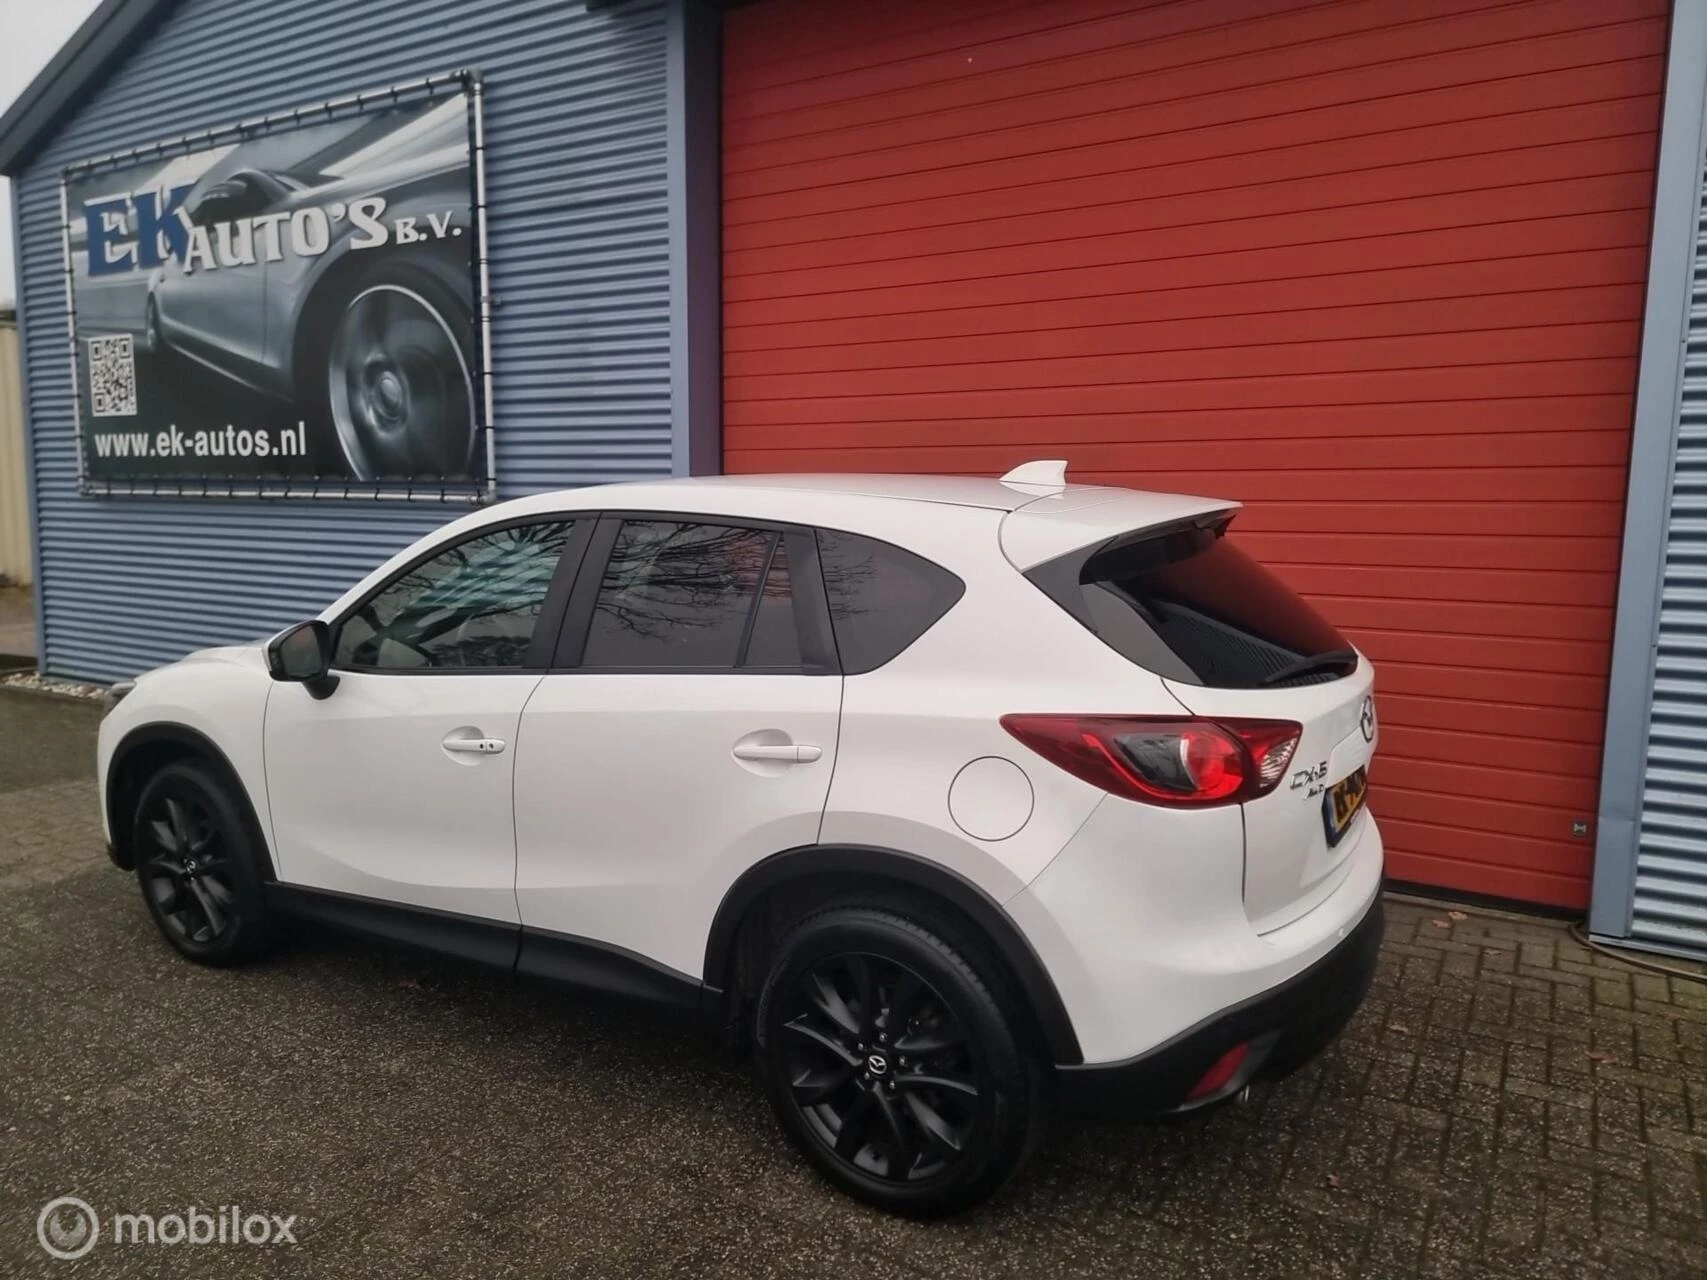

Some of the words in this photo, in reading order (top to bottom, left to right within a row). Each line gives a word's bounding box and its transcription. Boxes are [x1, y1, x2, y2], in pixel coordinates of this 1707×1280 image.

[84, 182, 198, 277] EK
[396, 211, 462, 244] B.V.
[95, 421, 306, 456] www.ek-autos.nl
